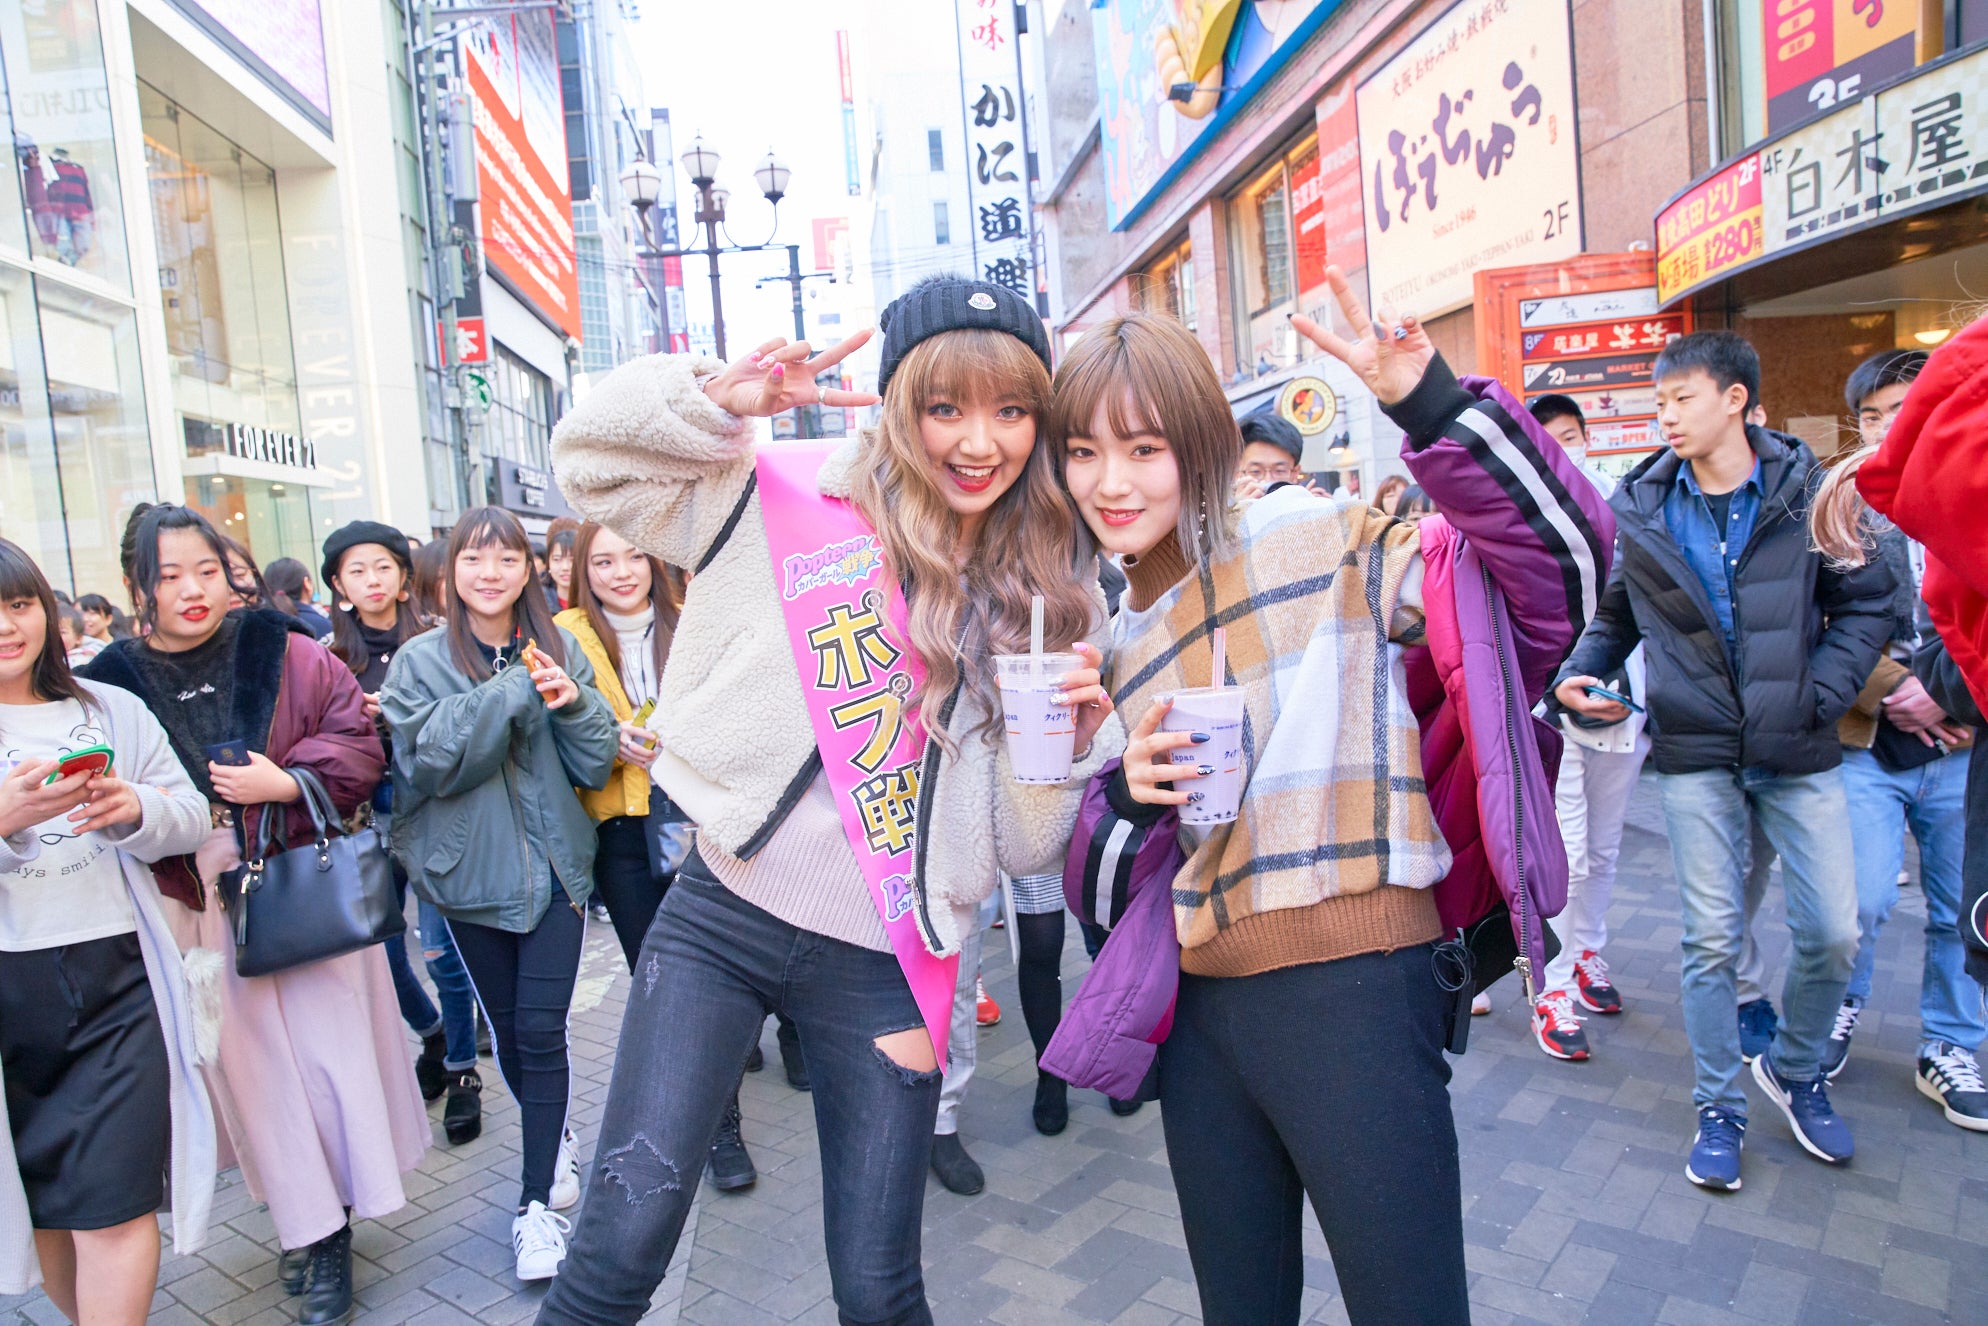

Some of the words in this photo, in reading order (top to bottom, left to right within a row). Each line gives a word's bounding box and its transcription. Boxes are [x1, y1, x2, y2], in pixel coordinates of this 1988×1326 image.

[1807, 73, 1861, 110] 2F
[1738, 156, 1758, 187] 2F
[1763, 149, 1782, 176] 4F
[1786, 91, 1970, 221] 白木屋
[1543, 200, 1569, 241] 2F
[1712, 218, 1752, 268] 280
[233, 421, 303, 468] FOREVER
[303, 437, 319, 470] 21
[842, 549, 875, 575] 戦争
[797, 568, 841, 593] カバーガール
[1171, 752, 1195, 763] Japan
